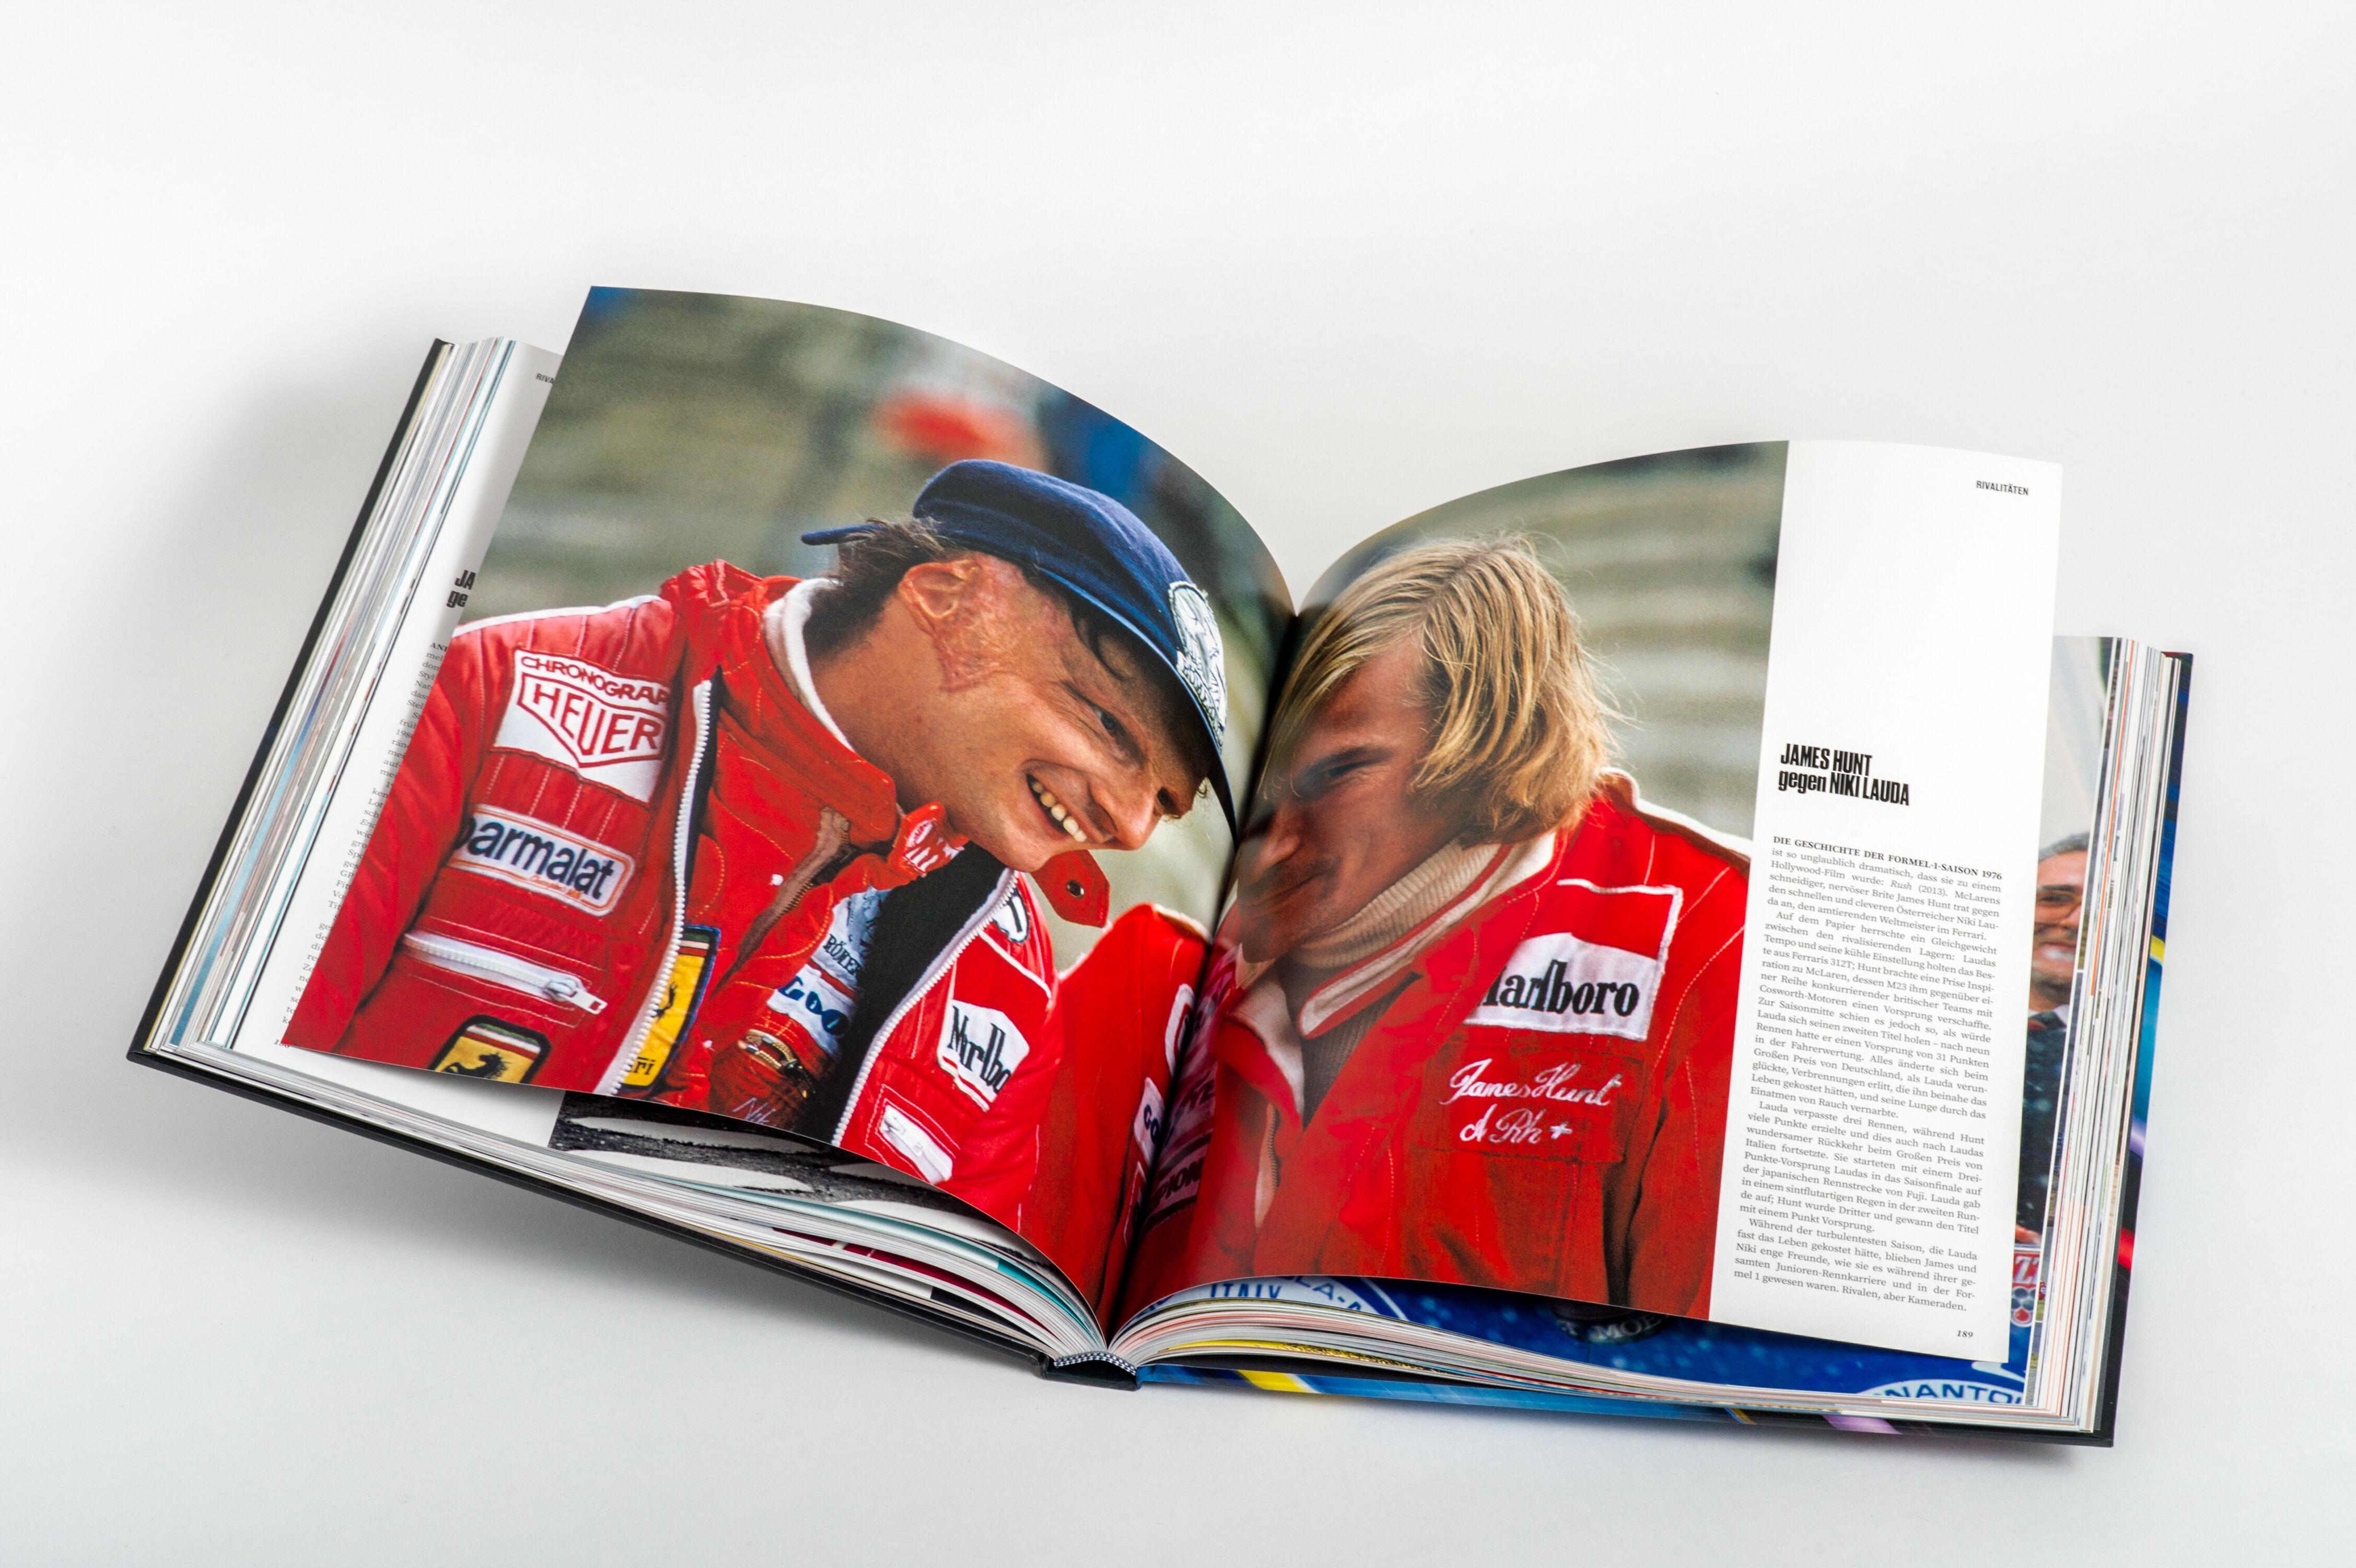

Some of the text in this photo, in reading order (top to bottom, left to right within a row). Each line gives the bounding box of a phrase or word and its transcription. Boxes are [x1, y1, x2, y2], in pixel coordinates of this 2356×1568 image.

[1976, 480, 2028, 496] RIVALITÄTEN
[521, 656, 670, 706] CHRONOGRAP
[533, 683, 661, 756] HEUER
[1780, 743, 1873, 777] JAMES HUNT
[1778, 770, 1910, 806] gegen NIKI LAUDA
[466, 817, 615, 900] armalat
[1772, 848, 1783, 857] ist
[1801, 854, 1855, 868] unglaublich
[1859, 862, 1914, 879] dramatisch,
[1917, 872, 1938, 882] dass
[1941, 876, 1954, 885] sie
[1972, 881, 2001, 893] einem
[1773, 836, 2002, 880] DIE GESCHICHTE DER FORMEL-1-SAISON 1976
[1769, 873, 1999, 917] schneidiger, nervöser Brite James Hunt trat gegen
[1771, 860, 2000, 905] Hollywood-Film wurde: Rush (2013). McLarens
[1768, 884, 1998, 929] den schnellen und cleveren Österreicher Niki Lau-
[1776, 911, 1997, 955] Auf dem Papier herrschte ein Gleichgewicht
[1764, 934, 1995, 979] Tempo und seine kühle Einstellung holten das Bes-
[1762, 961, 1790, 971] ration
[1806, 966, 1850, 981] McLaren,
[1852, 974, 1884, 987] dessen
[1887, 980, 1907, 990] M23
[1909, 984, 1928, 994] ihm
[1930, 989, 1980, 1002] gegenüber
[1759, 984, 1991, 1030] Cosworth-Motoren einen Vorsprung verschaffte.
[1756, 1022, 1792, 1036] Rennen
[1795, 1028, 1820, 1040] hatte
[1835, 1036, 1861, 1047] einen
[1864, 1040, 1914, 1058] Vorsprung
[1916, 1051, 1933, 1059] von
[1936, 1052, 1946, 1061] 31
[1950, 1055, 1989, 1068] Punkten
[1439, 1058, 1622, 1106] James Hunt
[1754, 1048, 1988, 1093] Großen Preis von Deutschland, als Lauda verun-
[1751, 1086, 1898, 1118] Einatmen von Rauch vernarbte.
[1747, 1113, 1984, 1157] viele Punkte erzielte und dies auch nach Laudas
[1746, 1138, 1982, 1183] Italien fortsetzte. Sie starteten mit einem Drei-
[1743, 1164, 1980, 1209] der japanischen Rennstrecke von Fuji. Lauda gab
[1741, 1190, 1979, 1234] de auf; Hunt wurde Dritter und gewann den Titel
[1748, 1218, 1977, 1260] Während der turbulentesten Saison, die Lauda
[1736, 1243, 1756, 1254] Niki
[1760, 1248, 1783, 1259] enge
[1787, 1250, 1830, 1266] Freunde,
[1834, 1259, 1851, 1268] wie
[1855, 1261, 1869, 1270] sie
[1887, 1267, 1929, 1279] während
[1933, 1272, 1958, 1283] ihrer
[1961, 1279, 1976, 1287] ge-
[1734, 1271, 1752, 1279] mel
[1762, 1276, 1804, 1288] gewesen
[1806, 1282, 1839, 1293] waren.
[1842, 1285, 1881, 1300] Rivalen,
[1883, 1292, 1906, 1302] aber
[1908, 1295, 1967, 1311] Kameraden.
